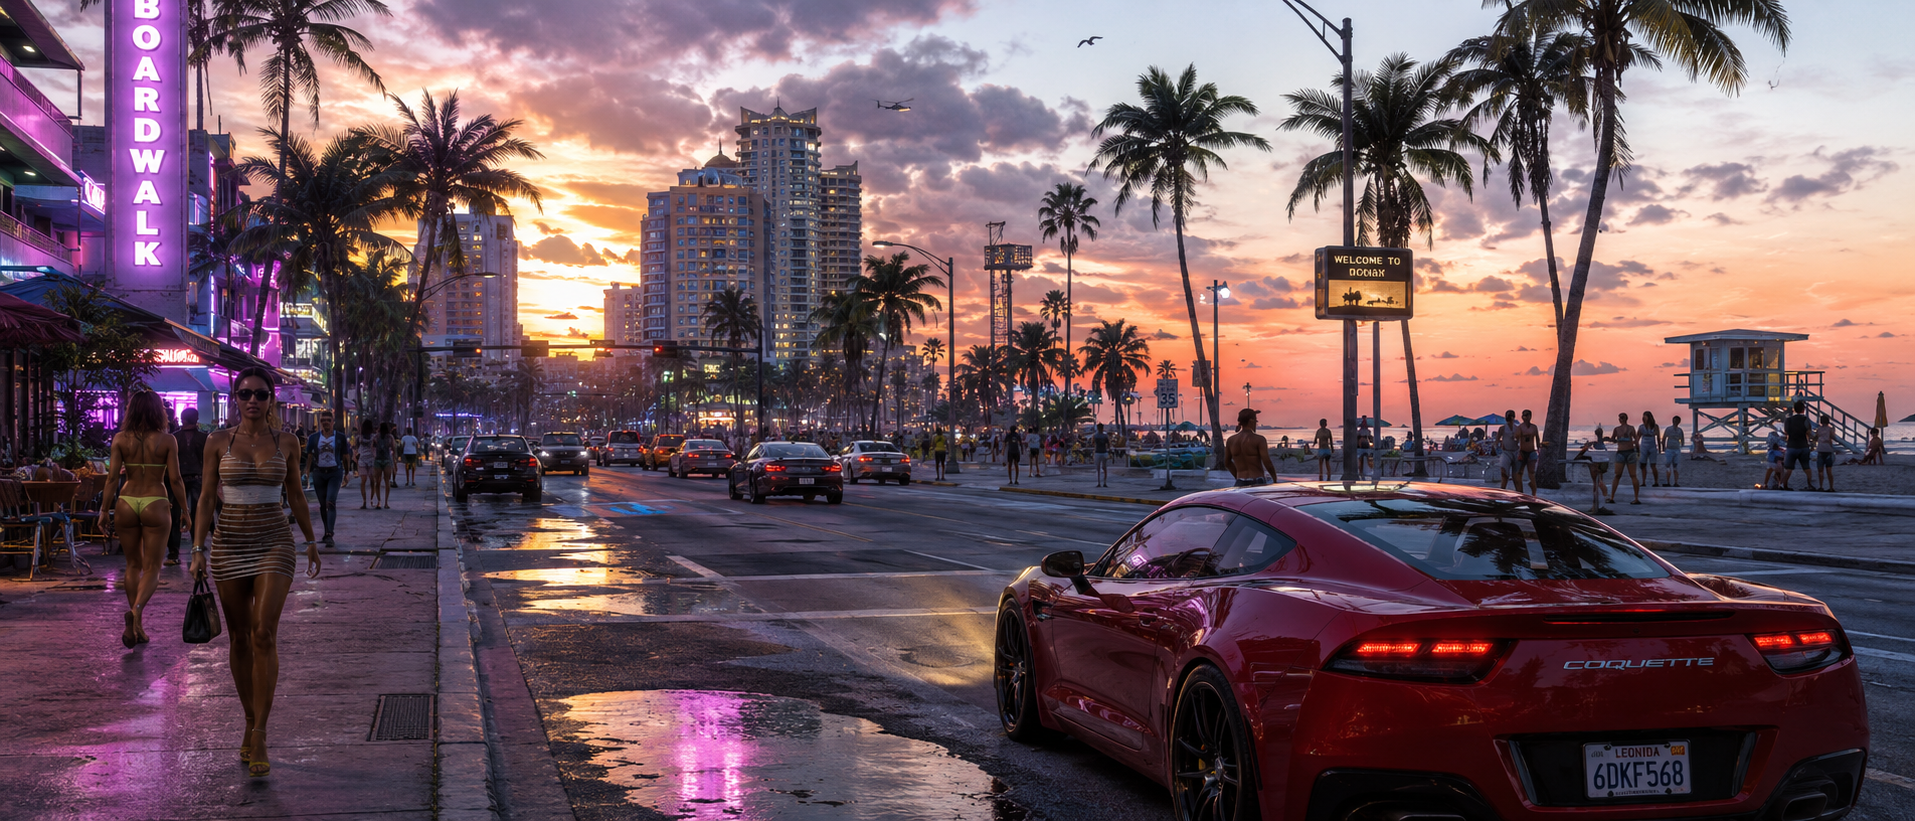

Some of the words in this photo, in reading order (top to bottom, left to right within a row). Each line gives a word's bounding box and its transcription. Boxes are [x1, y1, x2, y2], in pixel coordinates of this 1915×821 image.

[130, 0, 165, 266] BOARDWALK
[1334, 255, 1383, 265] WELCOME
[1388, 257, 1401, 266] TO
[1160, 393, 1176, 405] 35
[1563, 657, 1715, 671] COQUETTE
[1615, 747, 1660, 758] LEONIDA
[1593, 760, 1684, 790] 6DKF568
